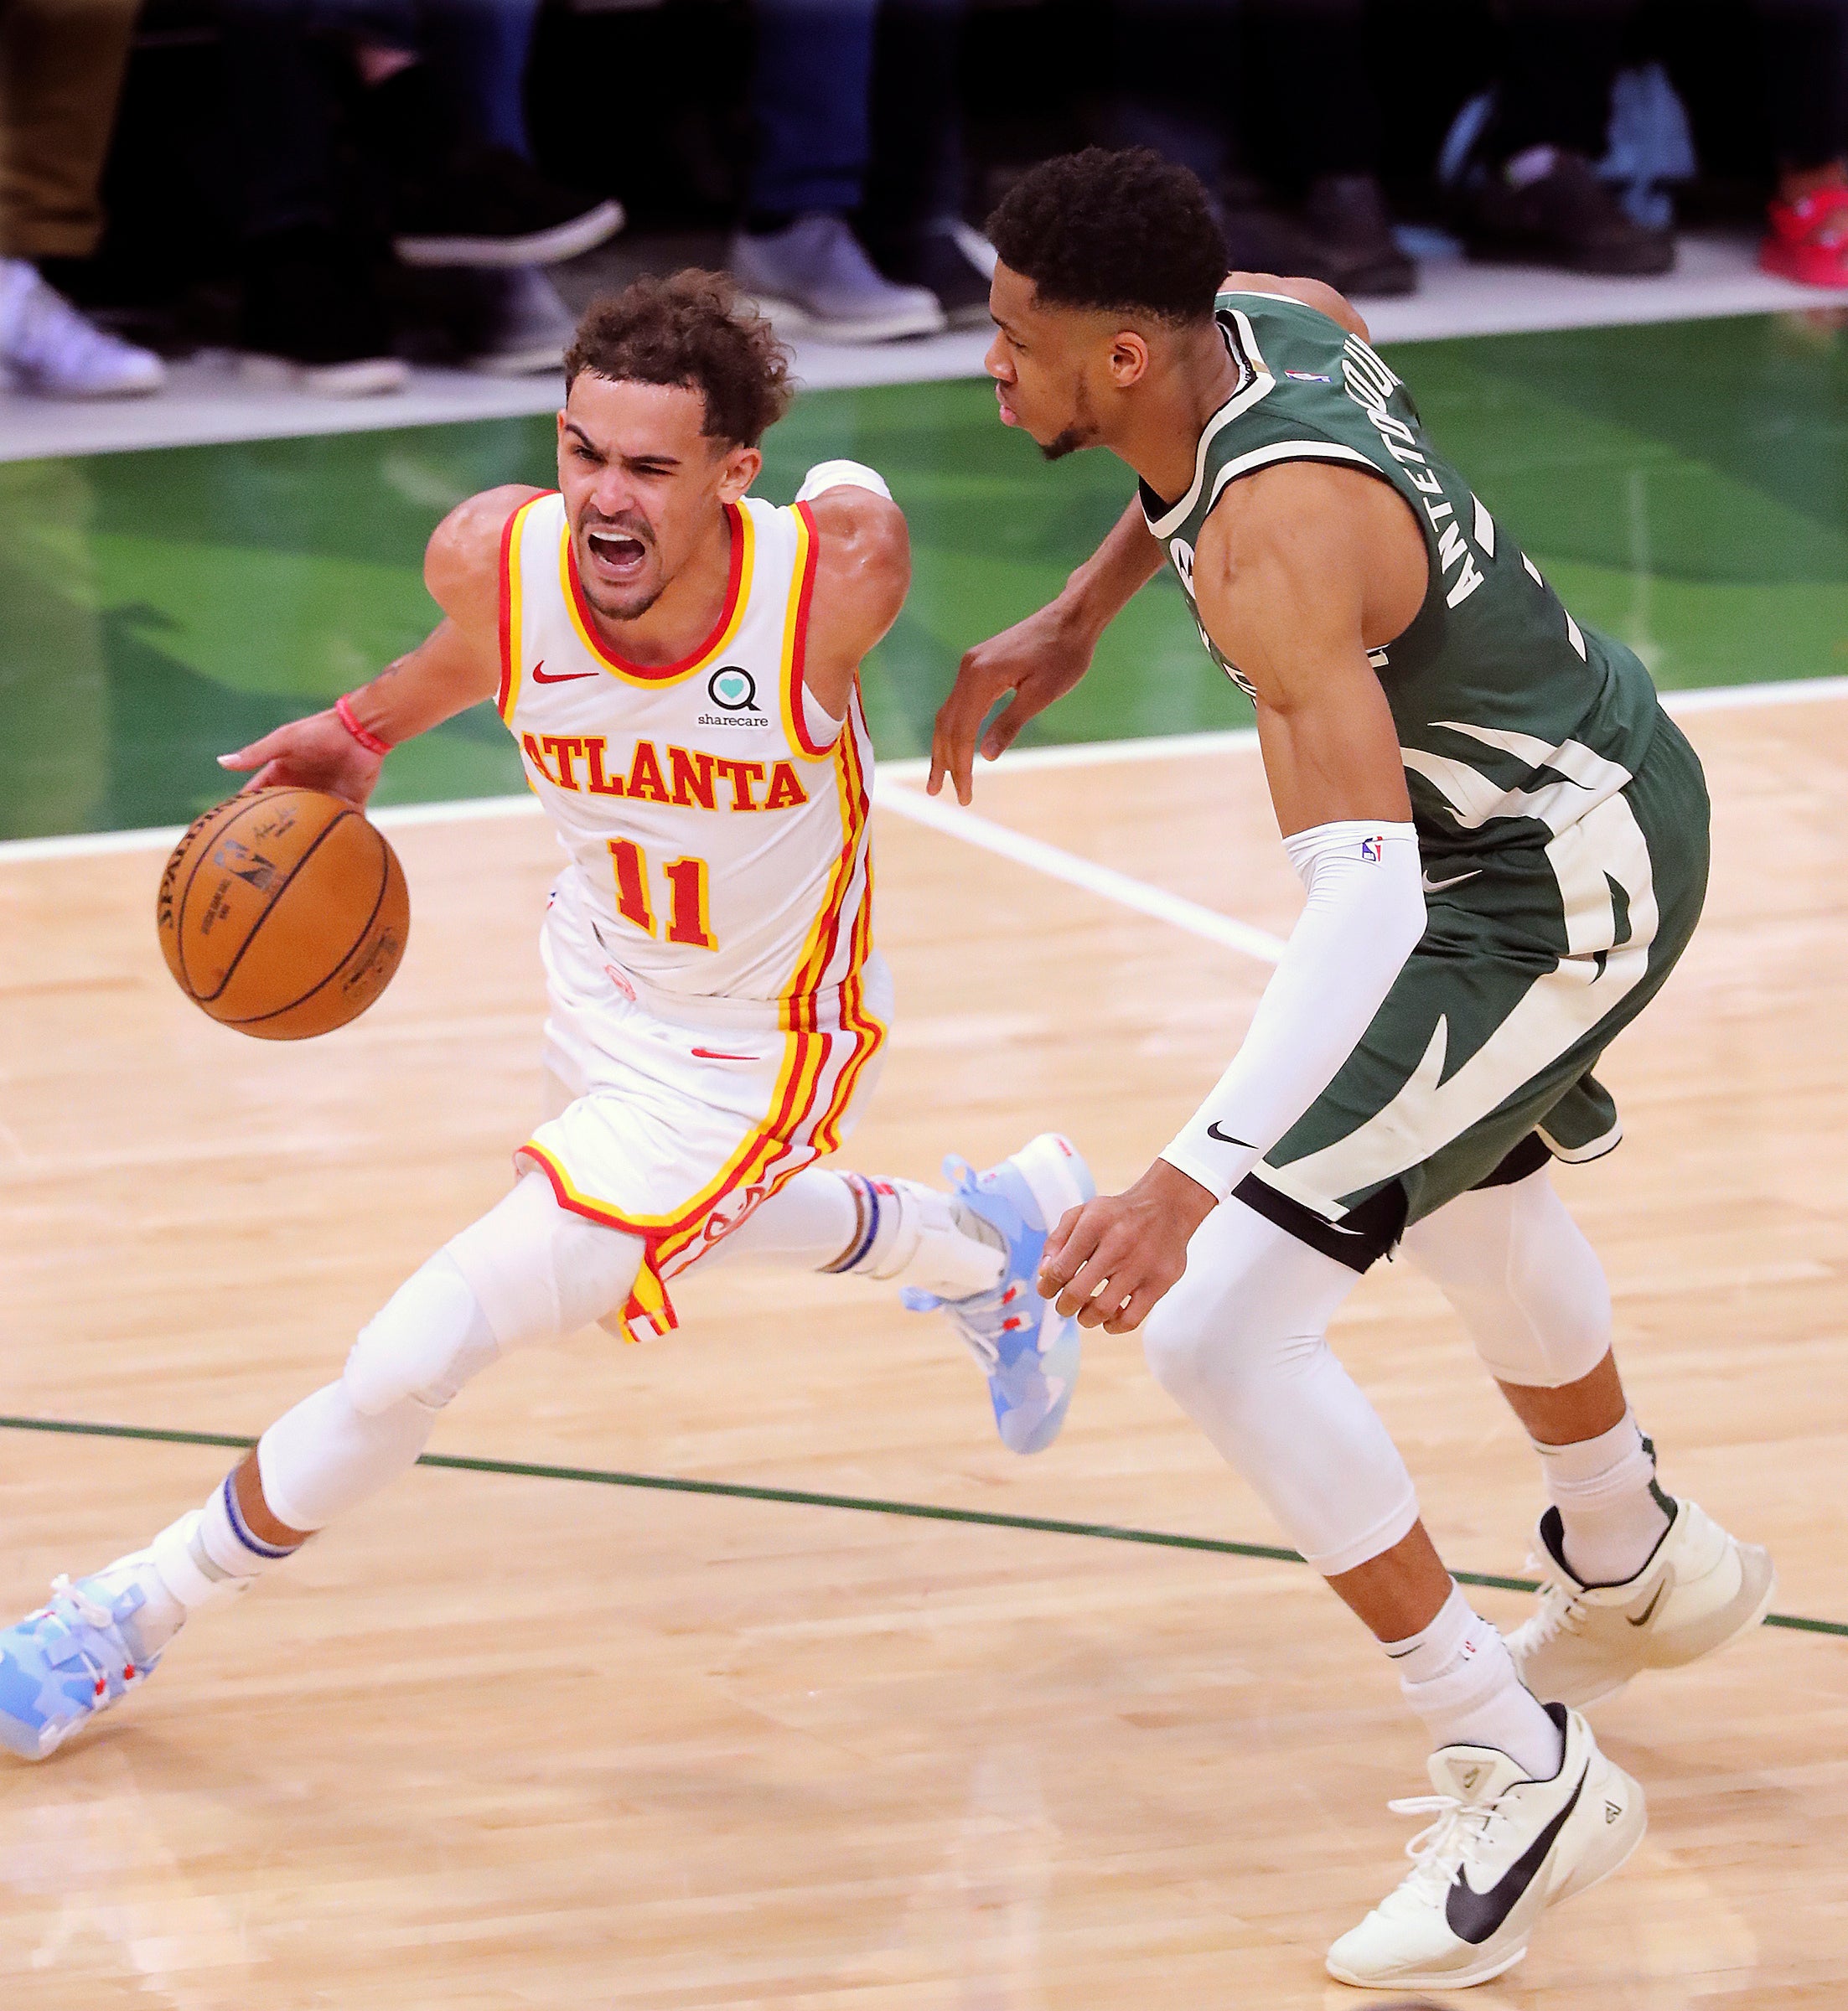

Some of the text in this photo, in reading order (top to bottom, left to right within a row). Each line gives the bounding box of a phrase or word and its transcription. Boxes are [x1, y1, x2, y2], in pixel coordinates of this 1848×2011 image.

[697, 713, 769, 726] sharecare
[520, 730, 810, 814] ATLANTA
[607, 836, 718, 952] 11
